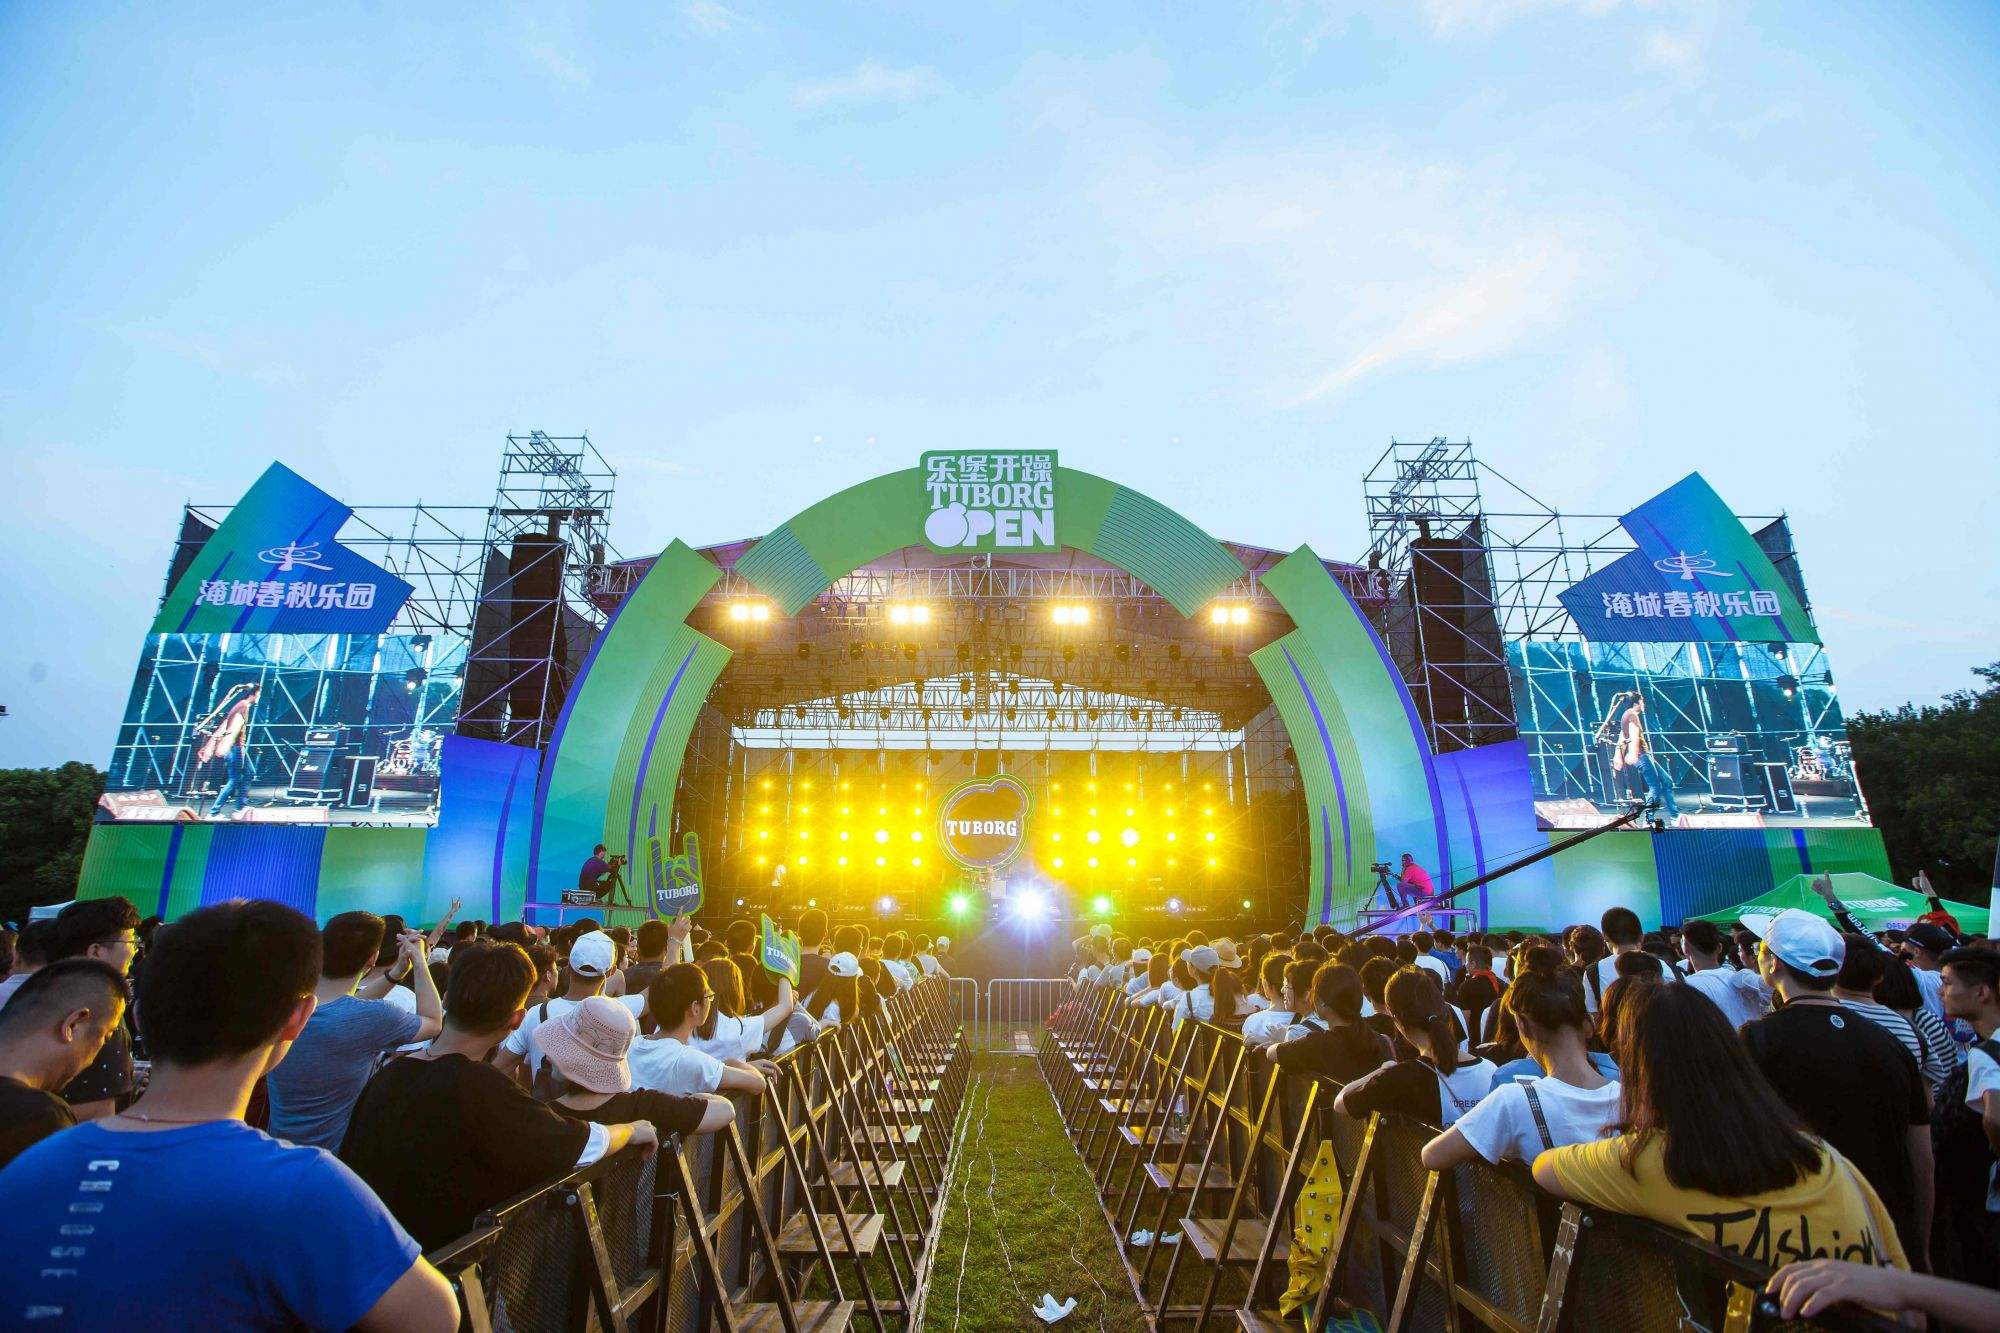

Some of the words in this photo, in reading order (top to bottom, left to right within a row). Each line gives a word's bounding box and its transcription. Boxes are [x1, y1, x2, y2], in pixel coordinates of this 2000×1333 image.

[926, 455, 1053, 482] 乐堡开躁
[926, 481, 1054, 510] TUBORG
[924, 502, 1055, 548] OPEN
[195, 579, 377, 610] 淹城春秋乐园
[1602, 590, 1781, 619] 淹城春秋乐园
[947, 820, 1017, 836] TUBORG
[656, 883, 699, 901] TUBORG
[1734, 905, 1788, 916] TUBOR
[1886, 921, 1908, 929] OPEN
